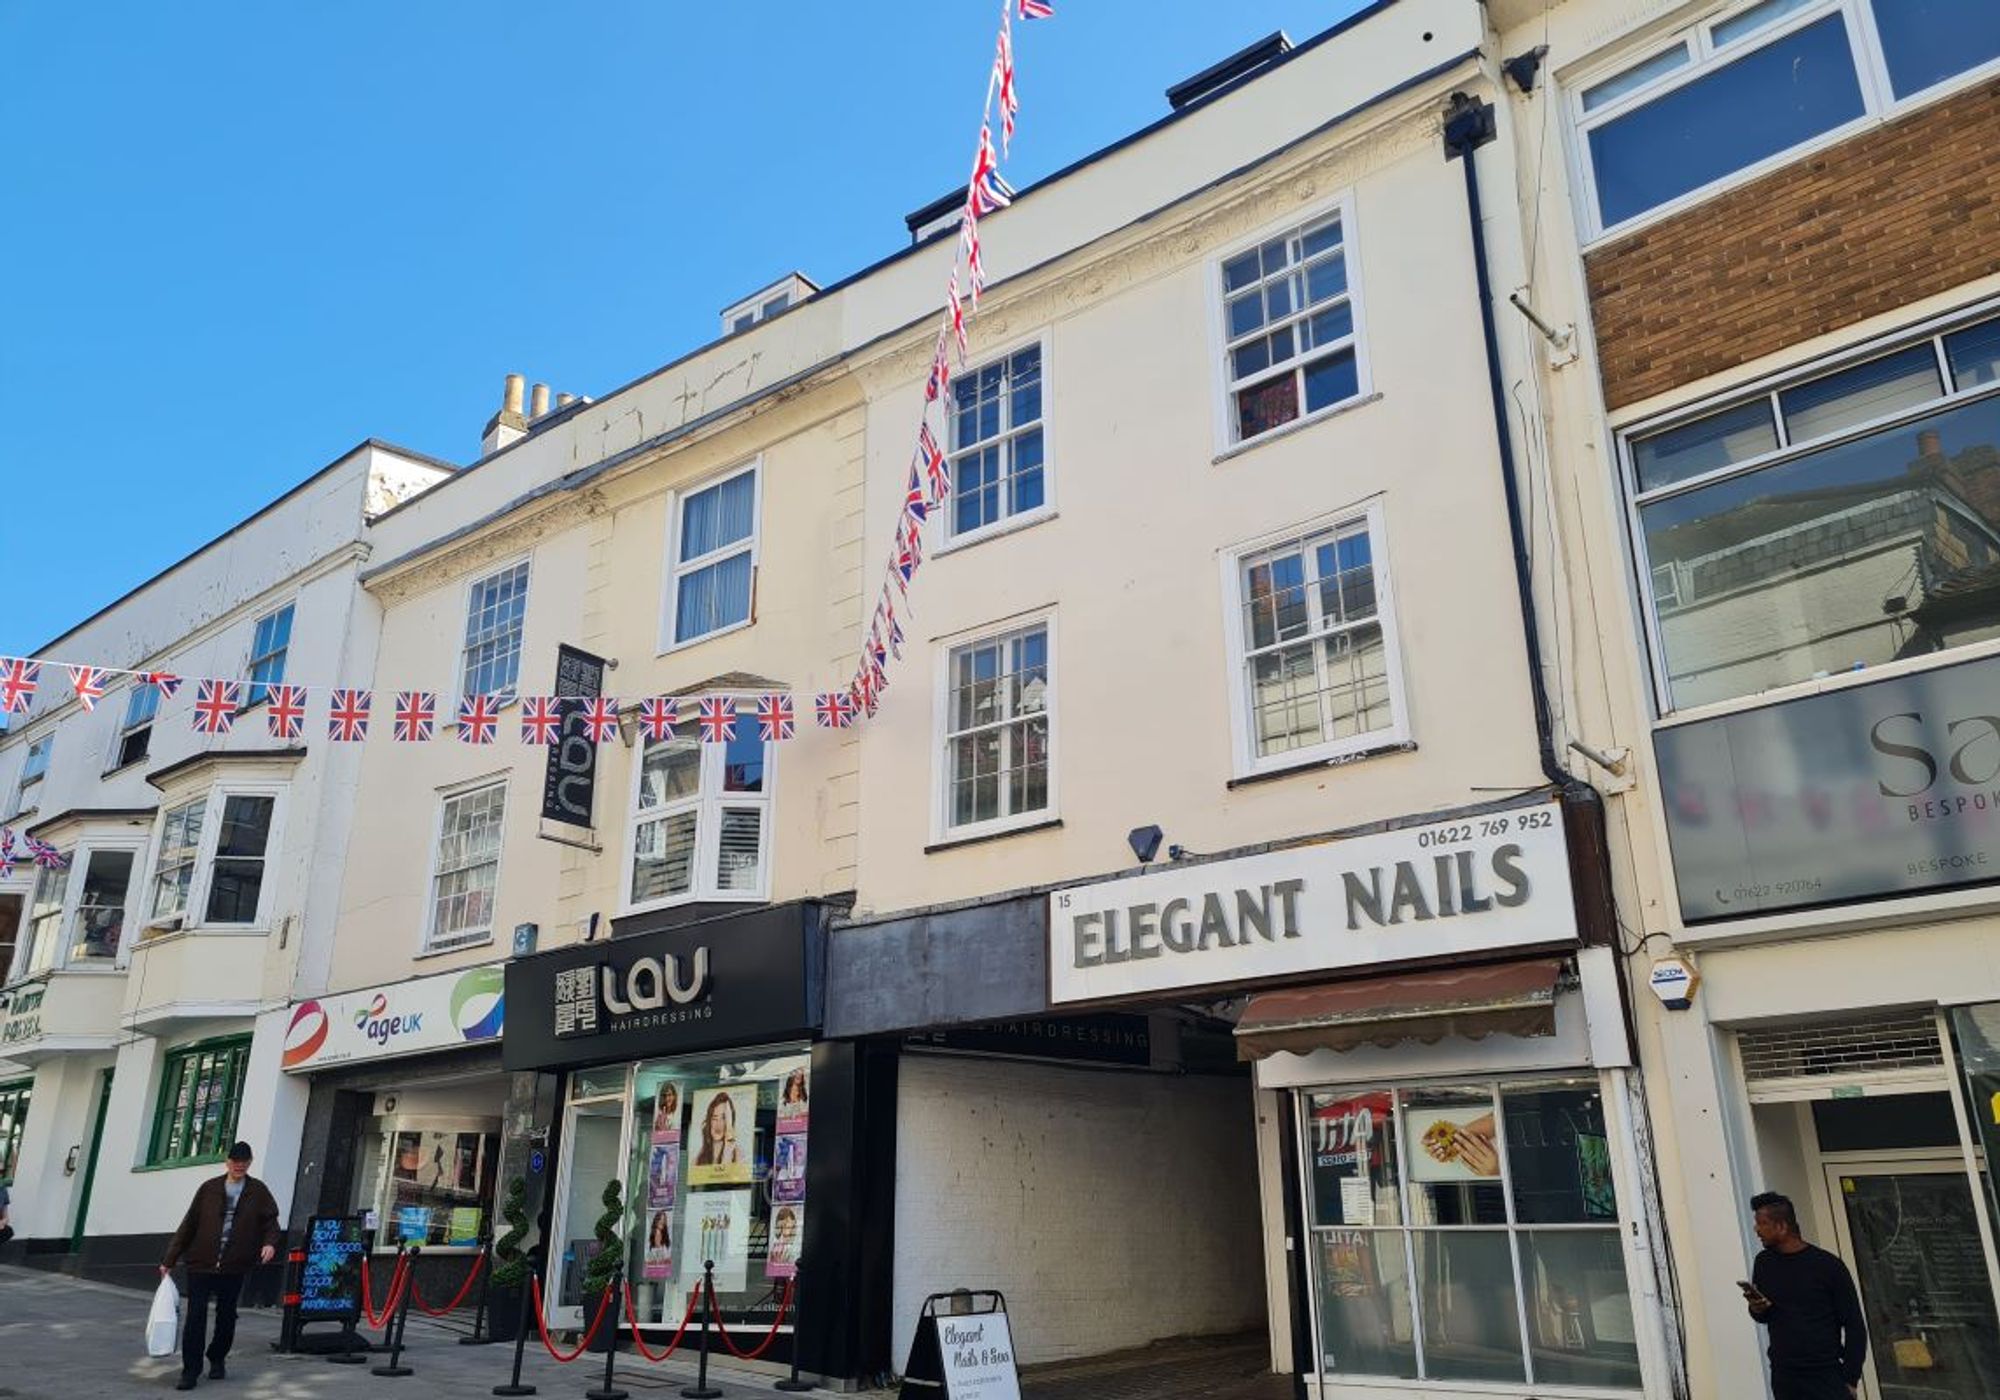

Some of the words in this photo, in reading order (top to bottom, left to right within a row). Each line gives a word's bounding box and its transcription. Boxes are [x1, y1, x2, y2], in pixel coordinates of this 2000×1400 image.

[1418, 825, 1472, 848] 01622
[1481, 818, 1509, 839] 769
[1518, 811, 1552, 831] 952
[1907, 852, 1988, 875] BESPOKE
[1058, 895, 1071, 908] 15
[1073, 878, 1306, 968] ELEGANT
[1341, 843, 1532, 930] NAILS
[610, 1009, 713, 1033] HAIRDRESSING
[945, 1322, 984, 1349] Elegant
